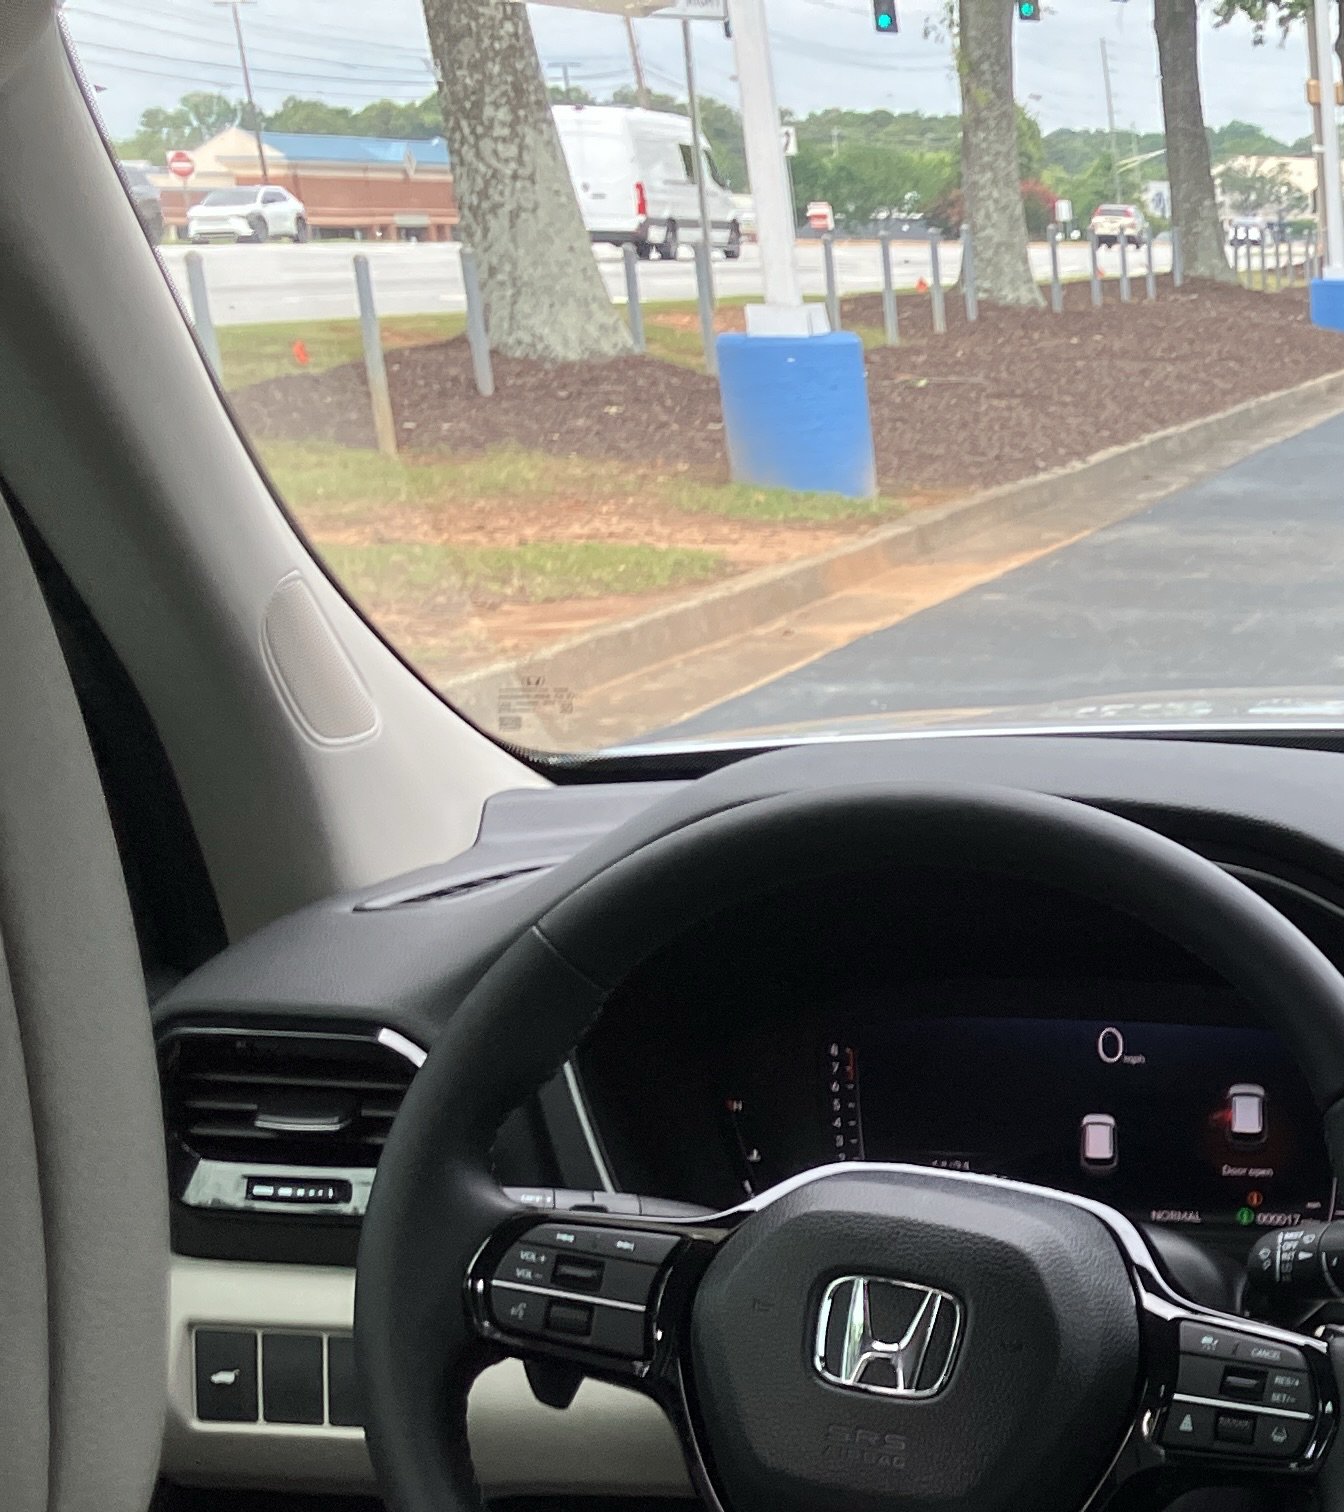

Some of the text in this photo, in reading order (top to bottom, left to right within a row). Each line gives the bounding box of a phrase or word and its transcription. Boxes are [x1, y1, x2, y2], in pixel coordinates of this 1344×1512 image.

[1098, 1026, 1146, 1066] 0 mph
[1222, 1164, 1274, 1178] Door open
[1150, 1209, 1201, 1223] NORMAL
[1256, 1212, 1302, 1226] 000017
[1250, 1347, 1282, 1361] CANCEL
